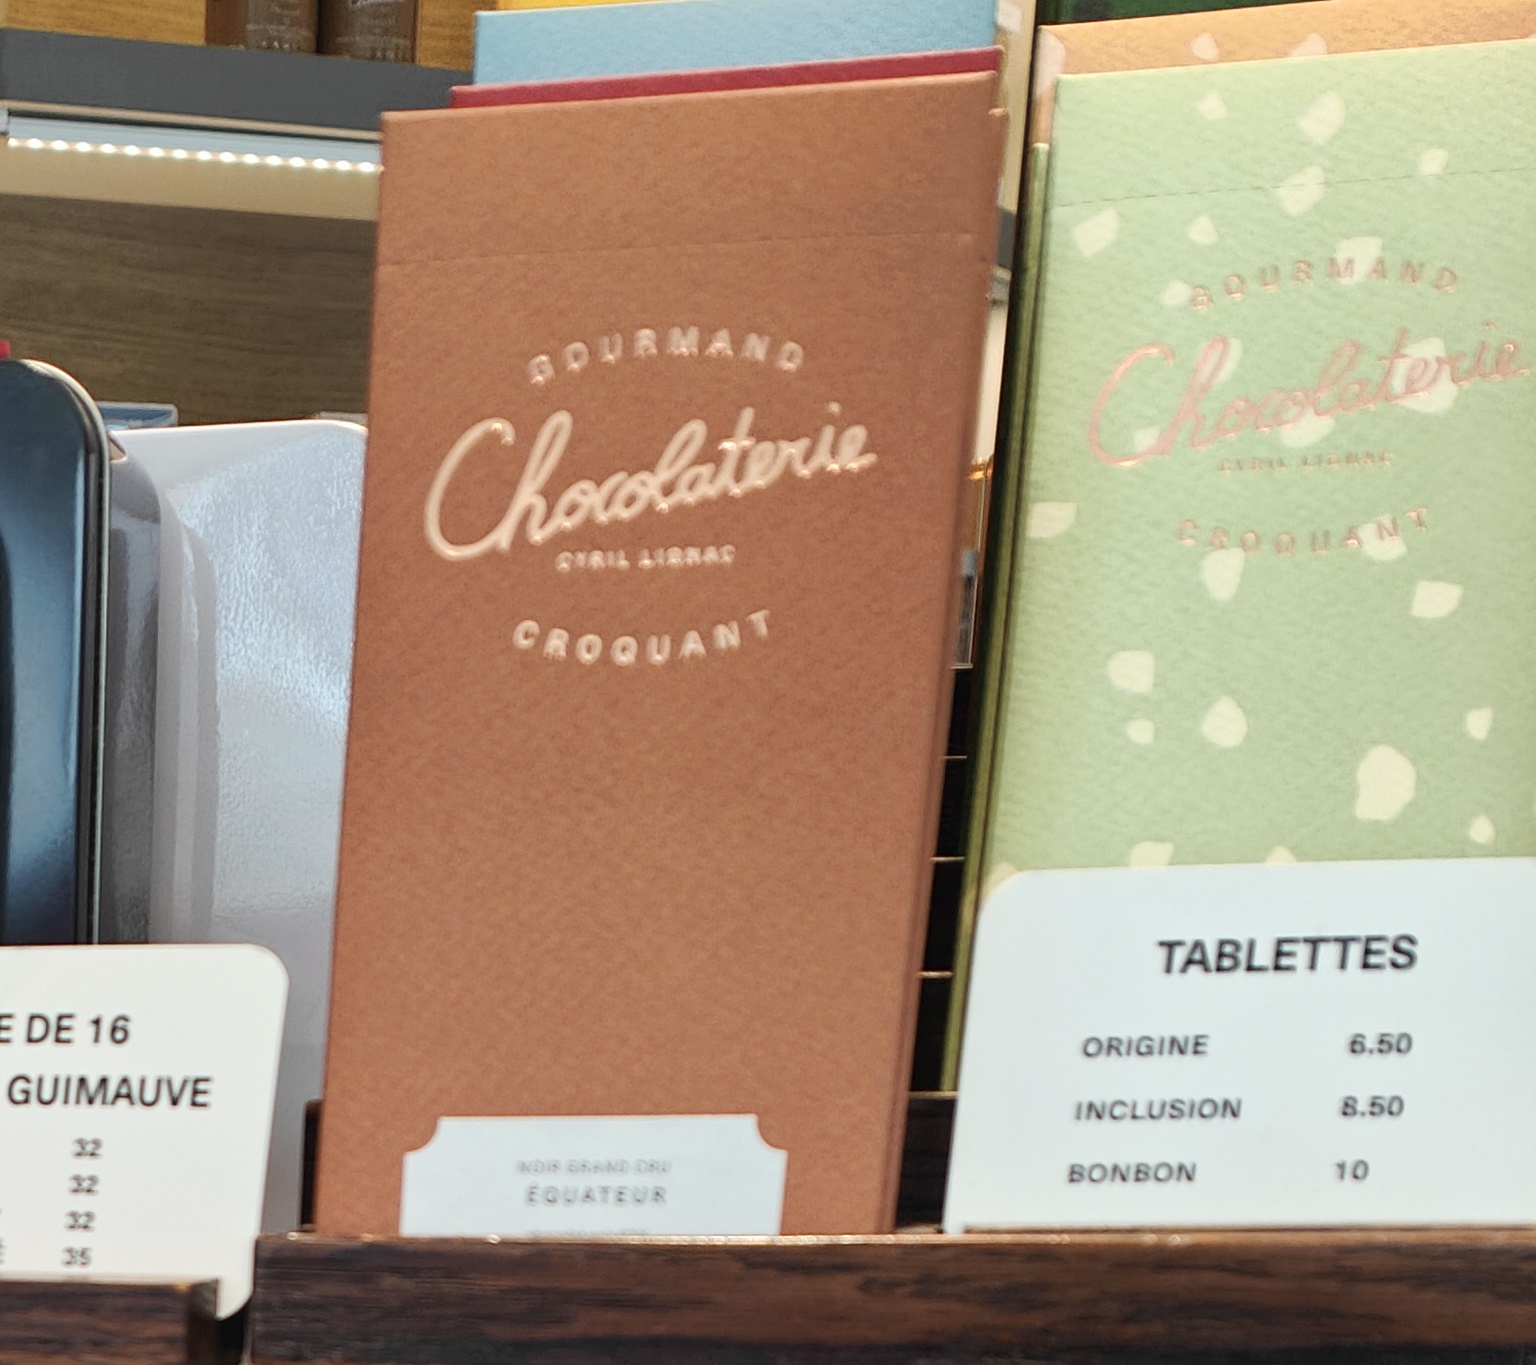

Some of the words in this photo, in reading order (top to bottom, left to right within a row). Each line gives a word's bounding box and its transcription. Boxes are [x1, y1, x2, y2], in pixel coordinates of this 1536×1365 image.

[1188, 256, 1459, 311] GOURMAND
[527, 326, 804, 385] GOURMAND
[1087, 319, 1531, 469] Chocolaterie
[423, 401, 878, 561] Chocolaterie
[1176, 507, 1429, 557] CROQUANT
[512, 608, 771, 667] CROQUANT
[1158, 934, 1419, 974] TABLETTES
[26, 1013, 76, 1045] DE
[89, 1014, 131, 1045] 16
[1082, 1034, 1209, 1058] ORIGINE
[1349, 1032, 1413, 1056] 6.50
[8, 1074, 212, 1109] GUIMAUVE
[1074, 1097, 1242, 1121] INCLUSION
[1340, 1095, 1405, 1118] 8.50
[72, 1138, 102, 1158] 32
[69, 1174, 99, 1195] 32
[1068, 1162, 1196, 1184] BONBON
[1334, 1159, 1370, 1182] 10
[525, 1181, 667, 1206] ÉQUATEUR
[65, 1211, 95, 1231] 32
[63, 1246, 91, 1266] 35
